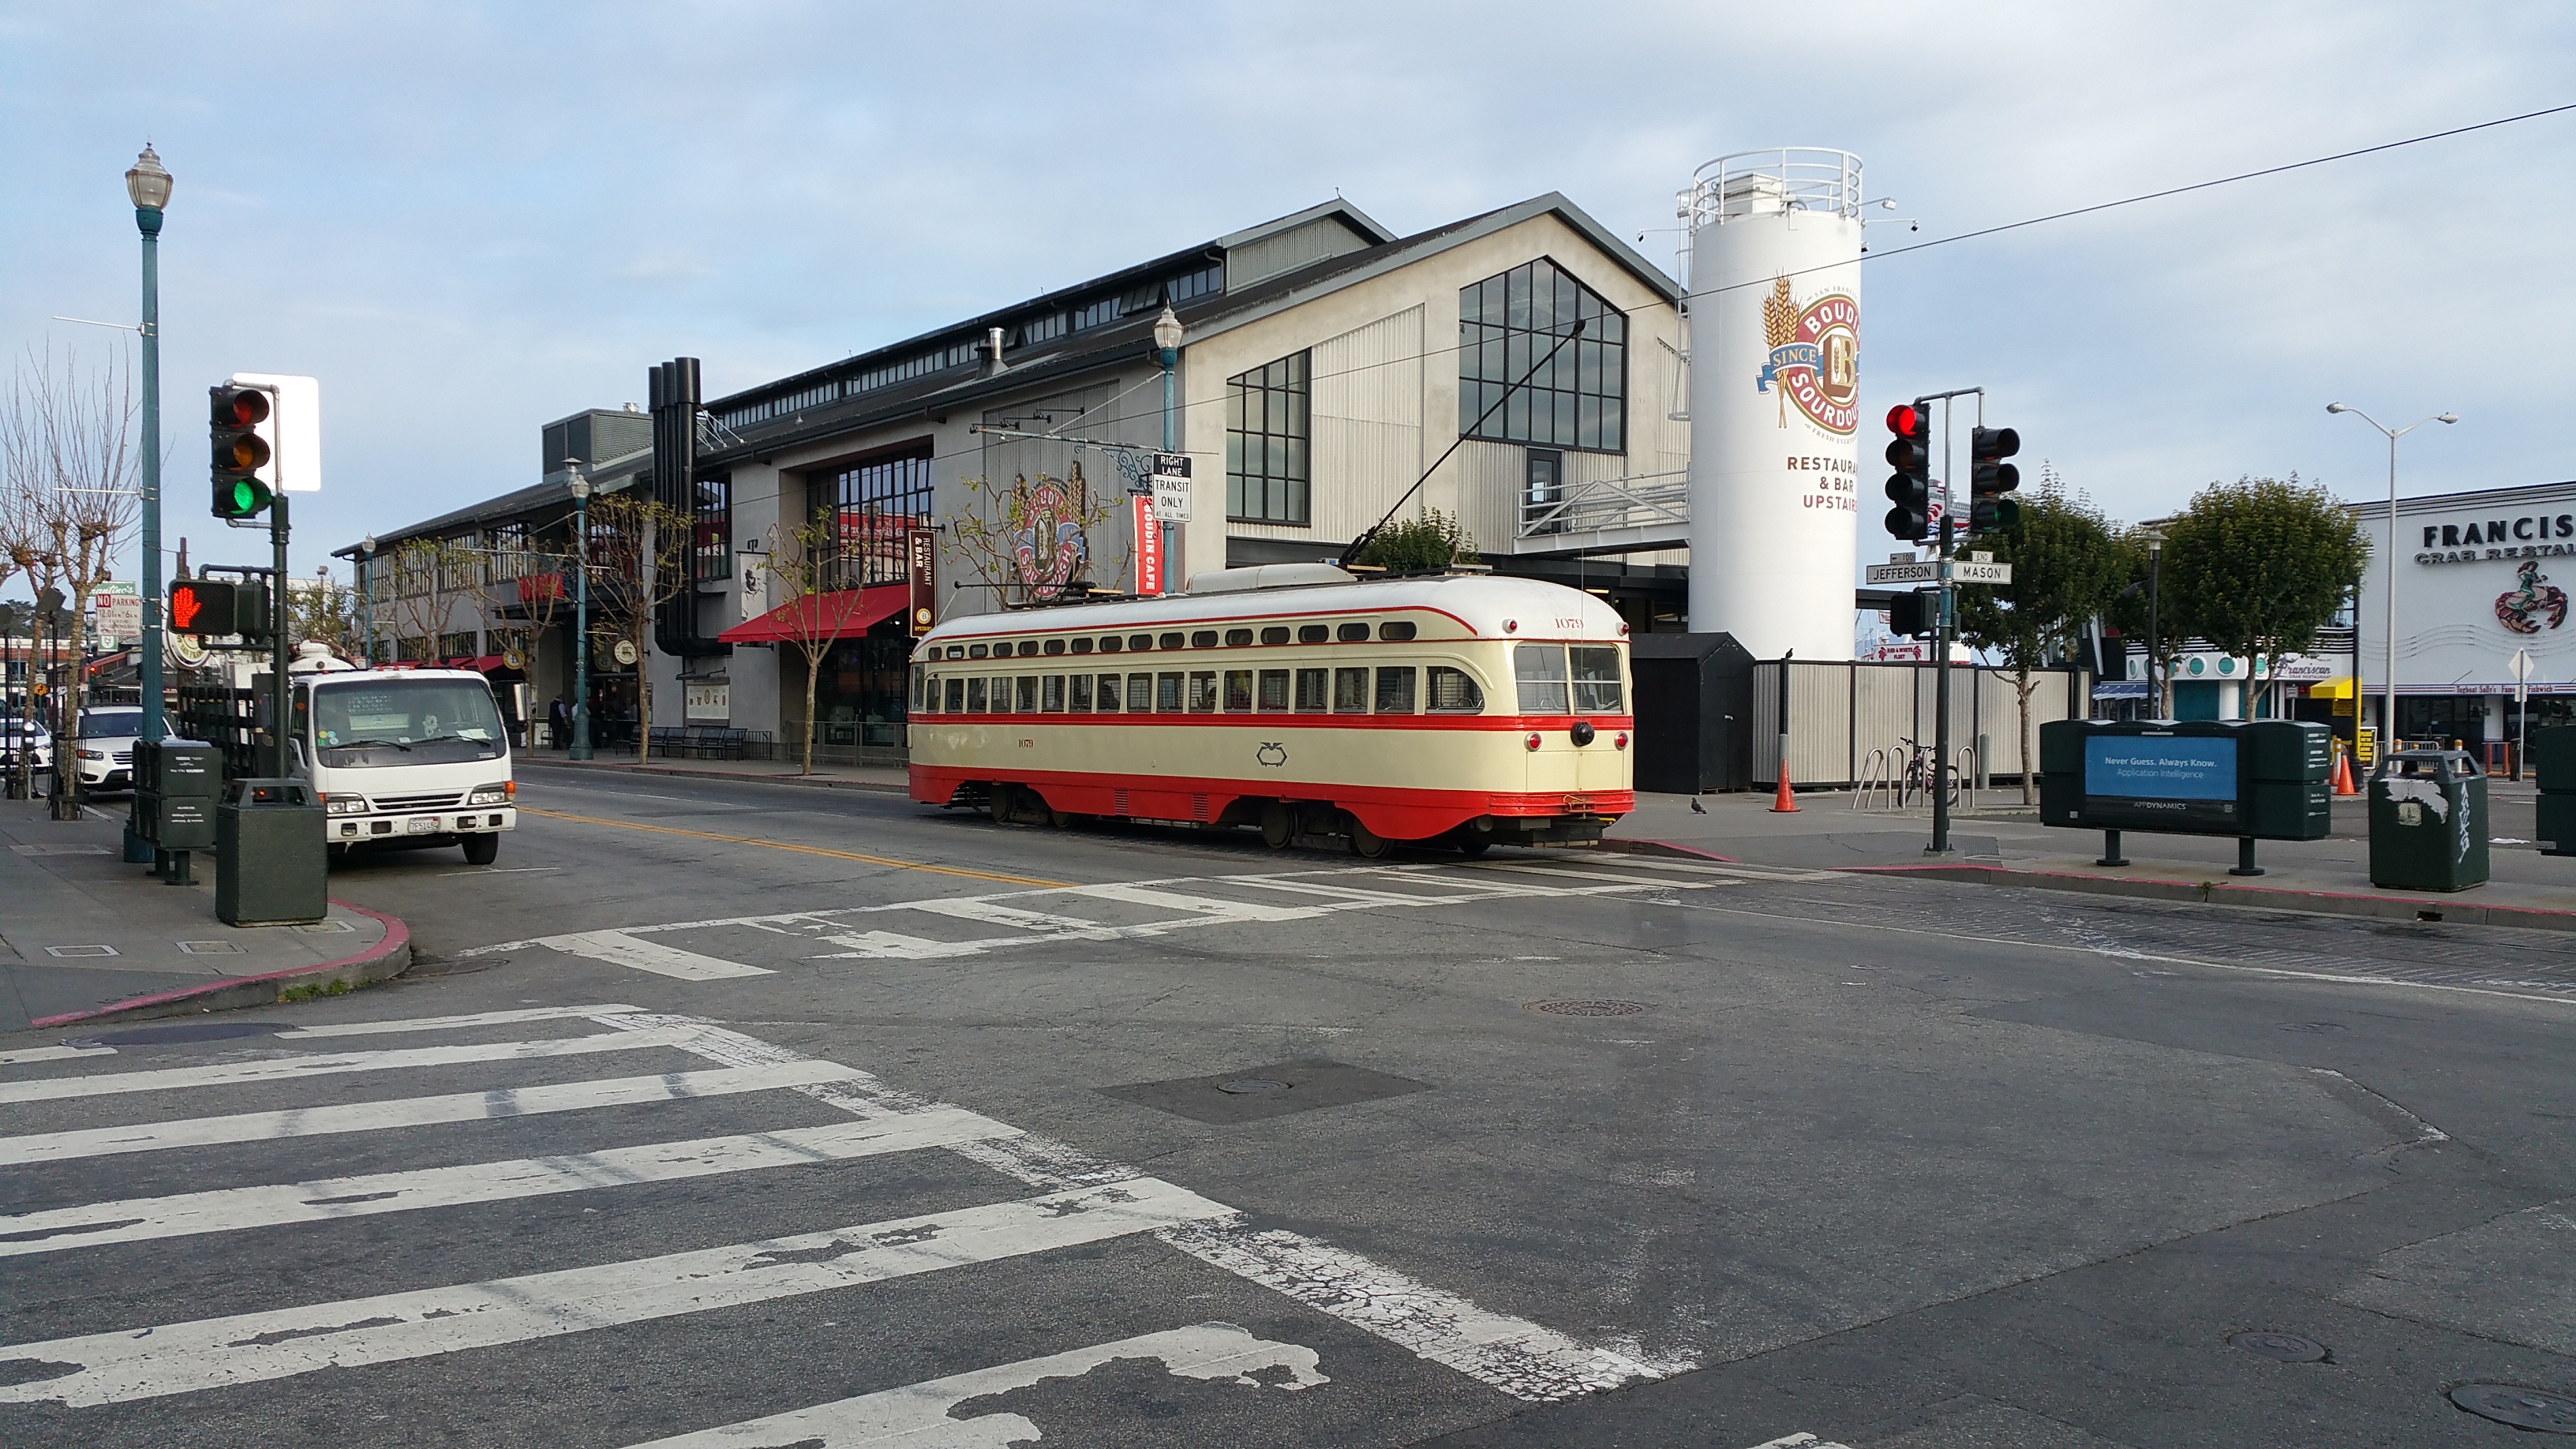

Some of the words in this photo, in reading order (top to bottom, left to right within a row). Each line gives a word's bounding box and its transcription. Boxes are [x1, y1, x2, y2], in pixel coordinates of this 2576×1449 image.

[1773, 348, 1817, 367] SINCE
[1812, 428, 1834, 442] FRESH
[1160, 455, 1184, 467] RIGHT
[1162, 466, 1183, 477] LANE
[1155, 479, 1189, 493] TRANSIT
[1819, 476, 1829, 490] &
[1834, 477, 1854, 493] BAR
[1161, 496, 1184, 508] ONLY
[2423, 514, 2574, 548] FRANCIS
[915, 537, 922, 545] &
[915, 546, 923, 568] BAR
[923, 537, 932, 586] RESTAURANT
[2413, 551, 2477, 565] CRAB
[1145, 556, 1155, 590] CAFE
[1874, 566, 1931, 580] JEFFERSON
[1963, 567, 2001, 578] MASON
[97, 595, 110, 606] NO
[112, 598, 140, 607] PARKING
[1555, 618, 1584, 629] 1079
[2275, 655, 2331, 678] Franciscan
[2479, 684, 2496, 695] Sally's
[2501, 684, 2516, 693] Famo
[2527, 684, 2553, 693] Fishwich
[1018, 739, 1034, 748] 1079
[2105, 757, 2129, 766] Never
[2159, 758, 2188, 768] Always
[2117, 769, 2159, 777] Application
[2160, 769, 2204, 780] Intelligence
[2134, 802, 2187, 811] APPDYNAMICS
